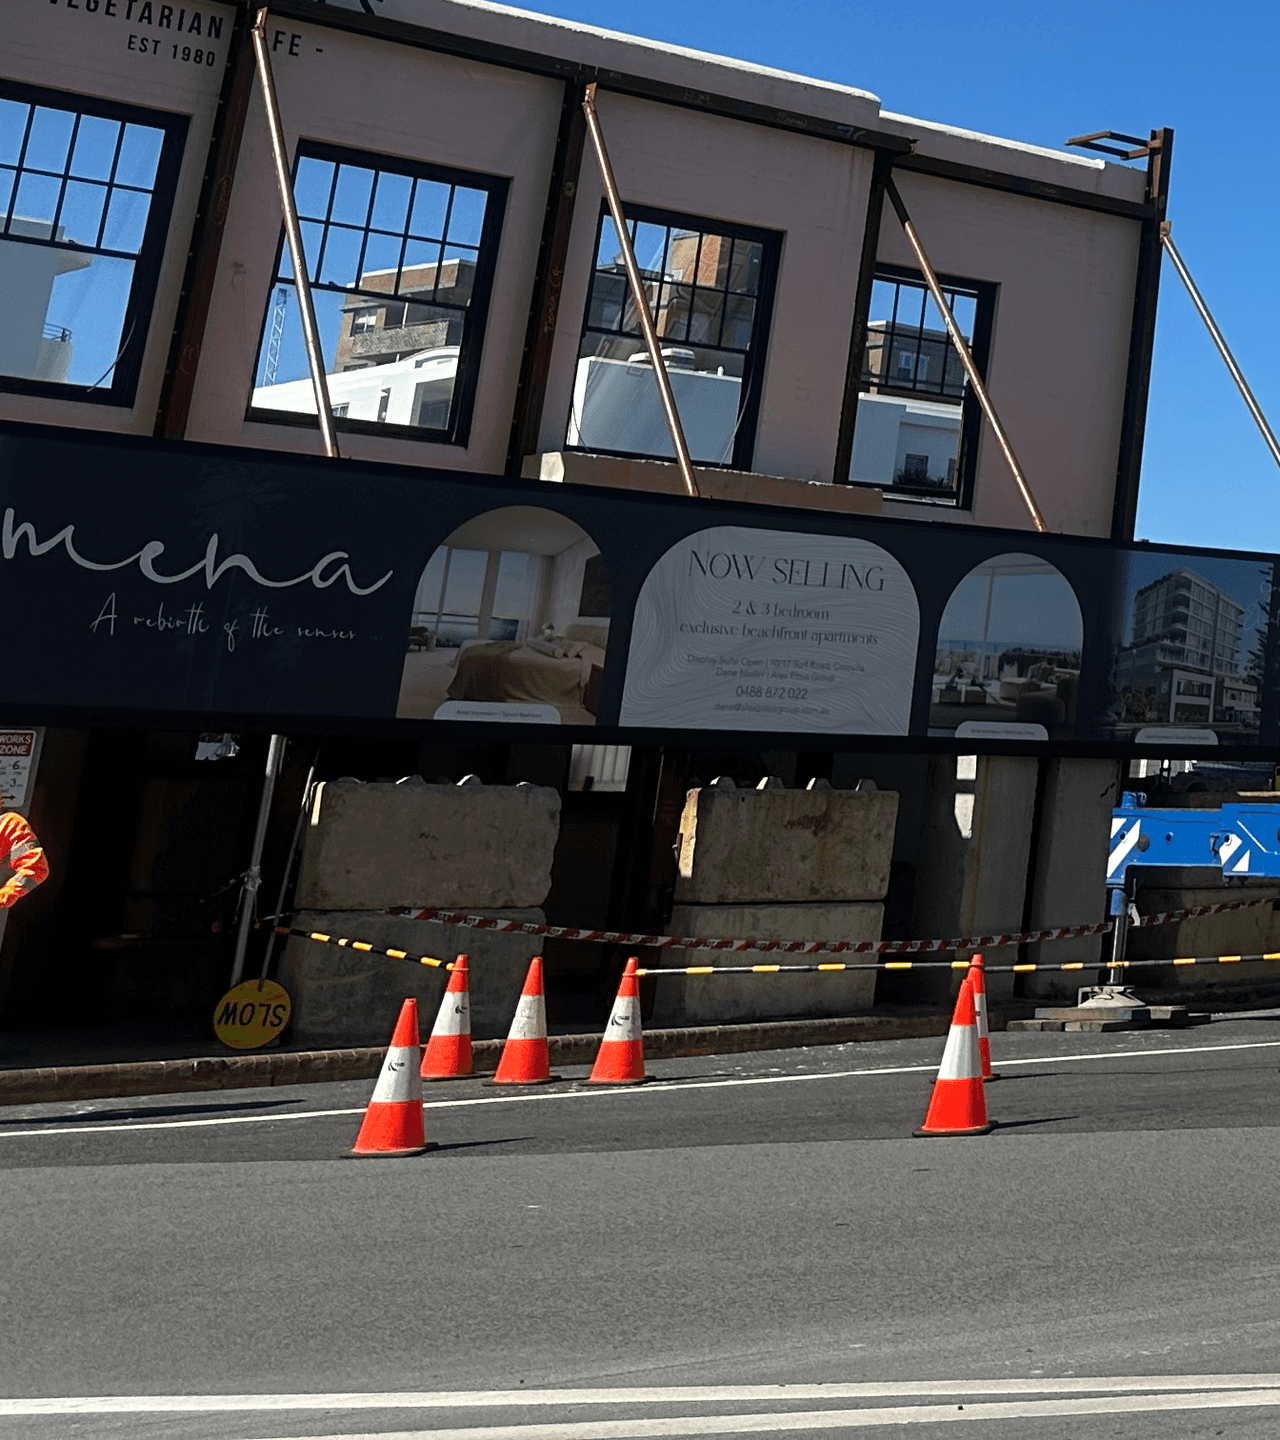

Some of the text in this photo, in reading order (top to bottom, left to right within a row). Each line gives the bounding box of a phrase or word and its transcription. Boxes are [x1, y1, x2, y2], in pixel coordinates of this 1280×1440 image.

[127, 35, 217, 67] EST 1980
[273, 30, 302, 57] FE
[688, 550, 884, 591] NOW SELLING
[89, 591, 356, 652] A rebirth of the senses
[732, 600, 830, 620] 2 & 3 bedroom
[680, 620, 878, 646] exclusive beachfront apartments
[735, 684, 809, 701] 0488 872 022
[0, 744, 28, 755] ZONE
[217, 1001, 287, 1028] SLOW
